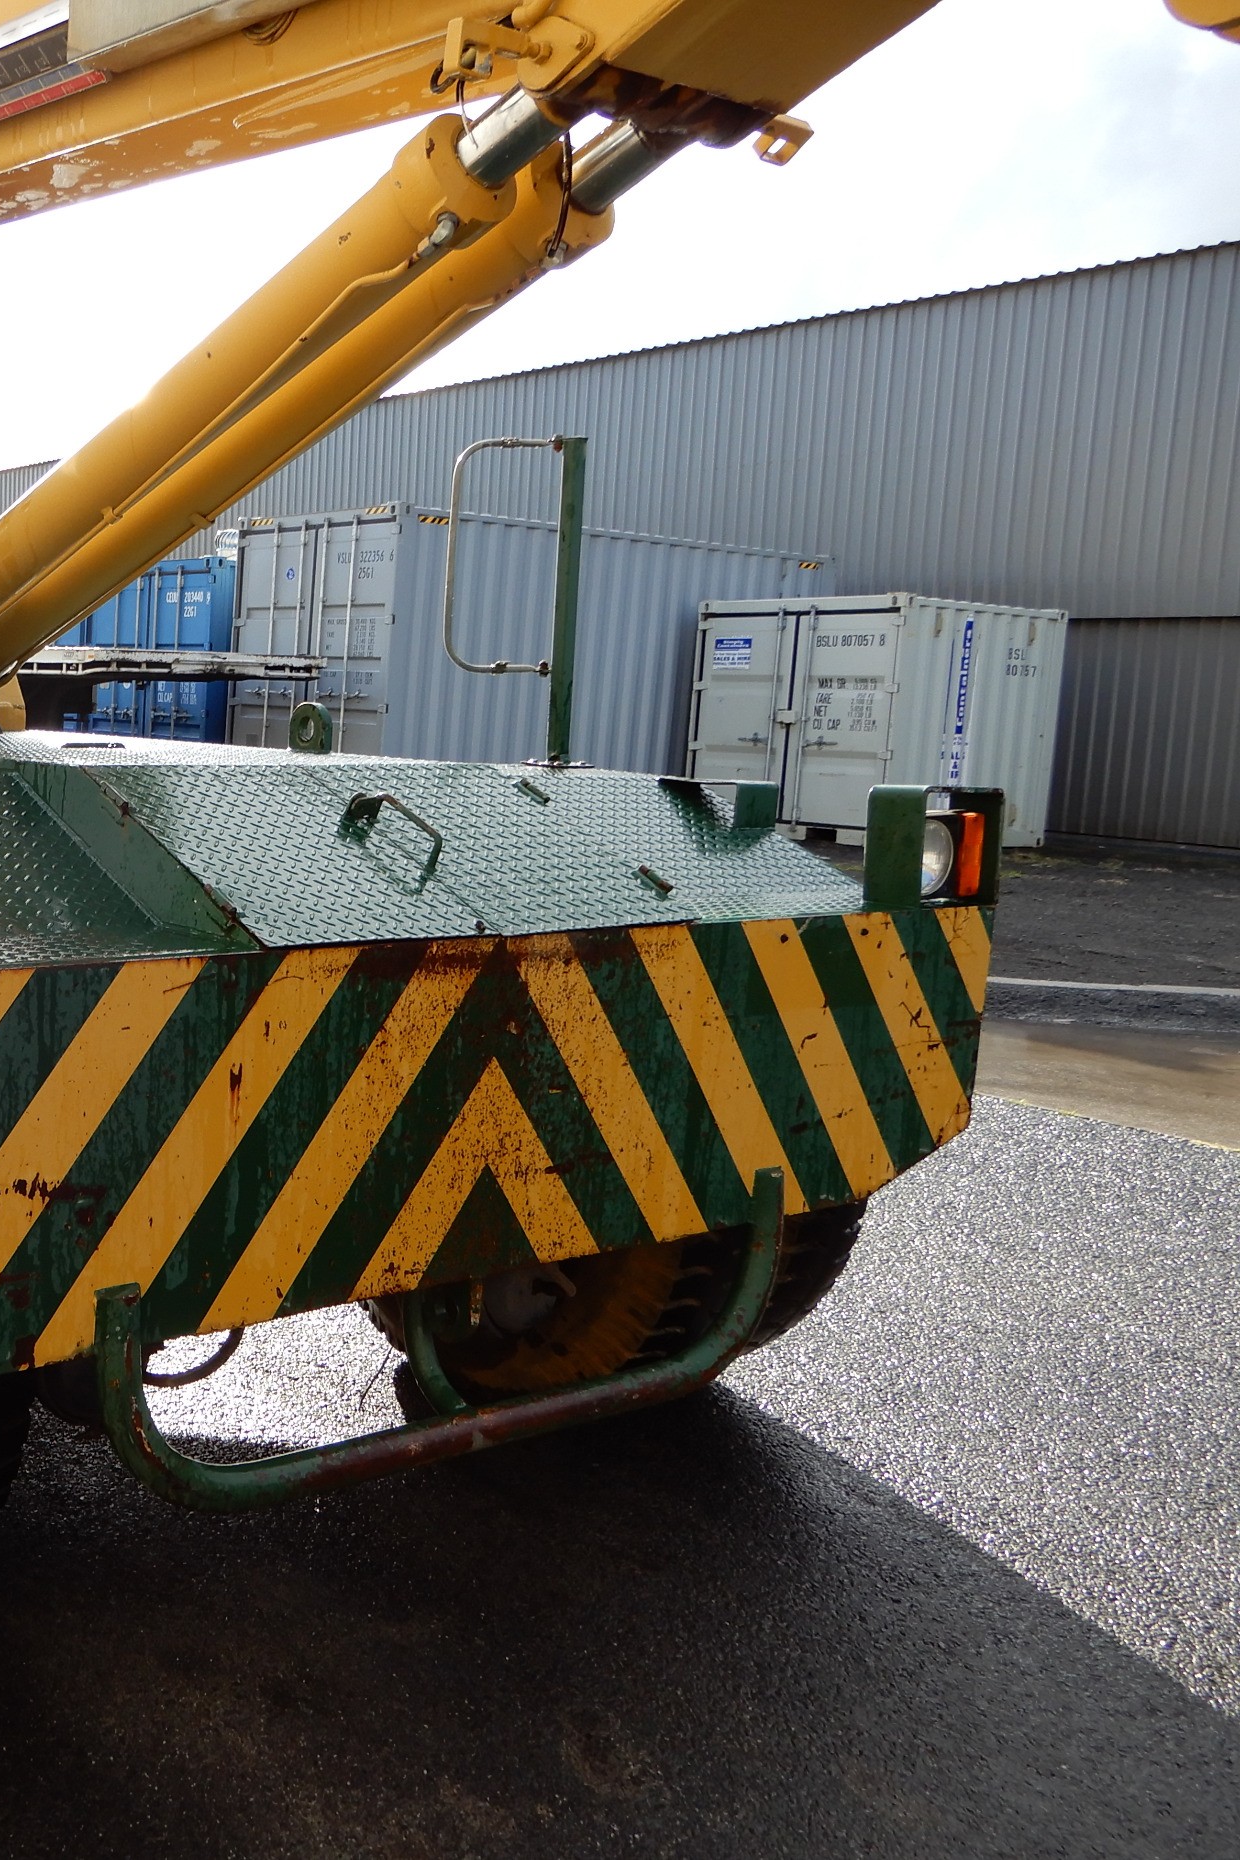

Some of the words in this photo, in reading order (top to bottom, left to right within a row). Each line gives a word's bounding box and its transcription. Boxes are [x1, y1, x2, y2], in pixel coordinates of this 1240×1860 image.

[360, 550, 385, 563] 322356
[389, 549, 394, 562] 6
[358, 566, 374, 579] 25G1
[816, 635, 838, 647] BSLU
[841, 634, 875, 647] 807057
[879, 633, 886, 647] 8
[818, 678, 833, 689] MAX
[816, 693, 833, 704] TARE
[813, 705, 827, 717] NET
